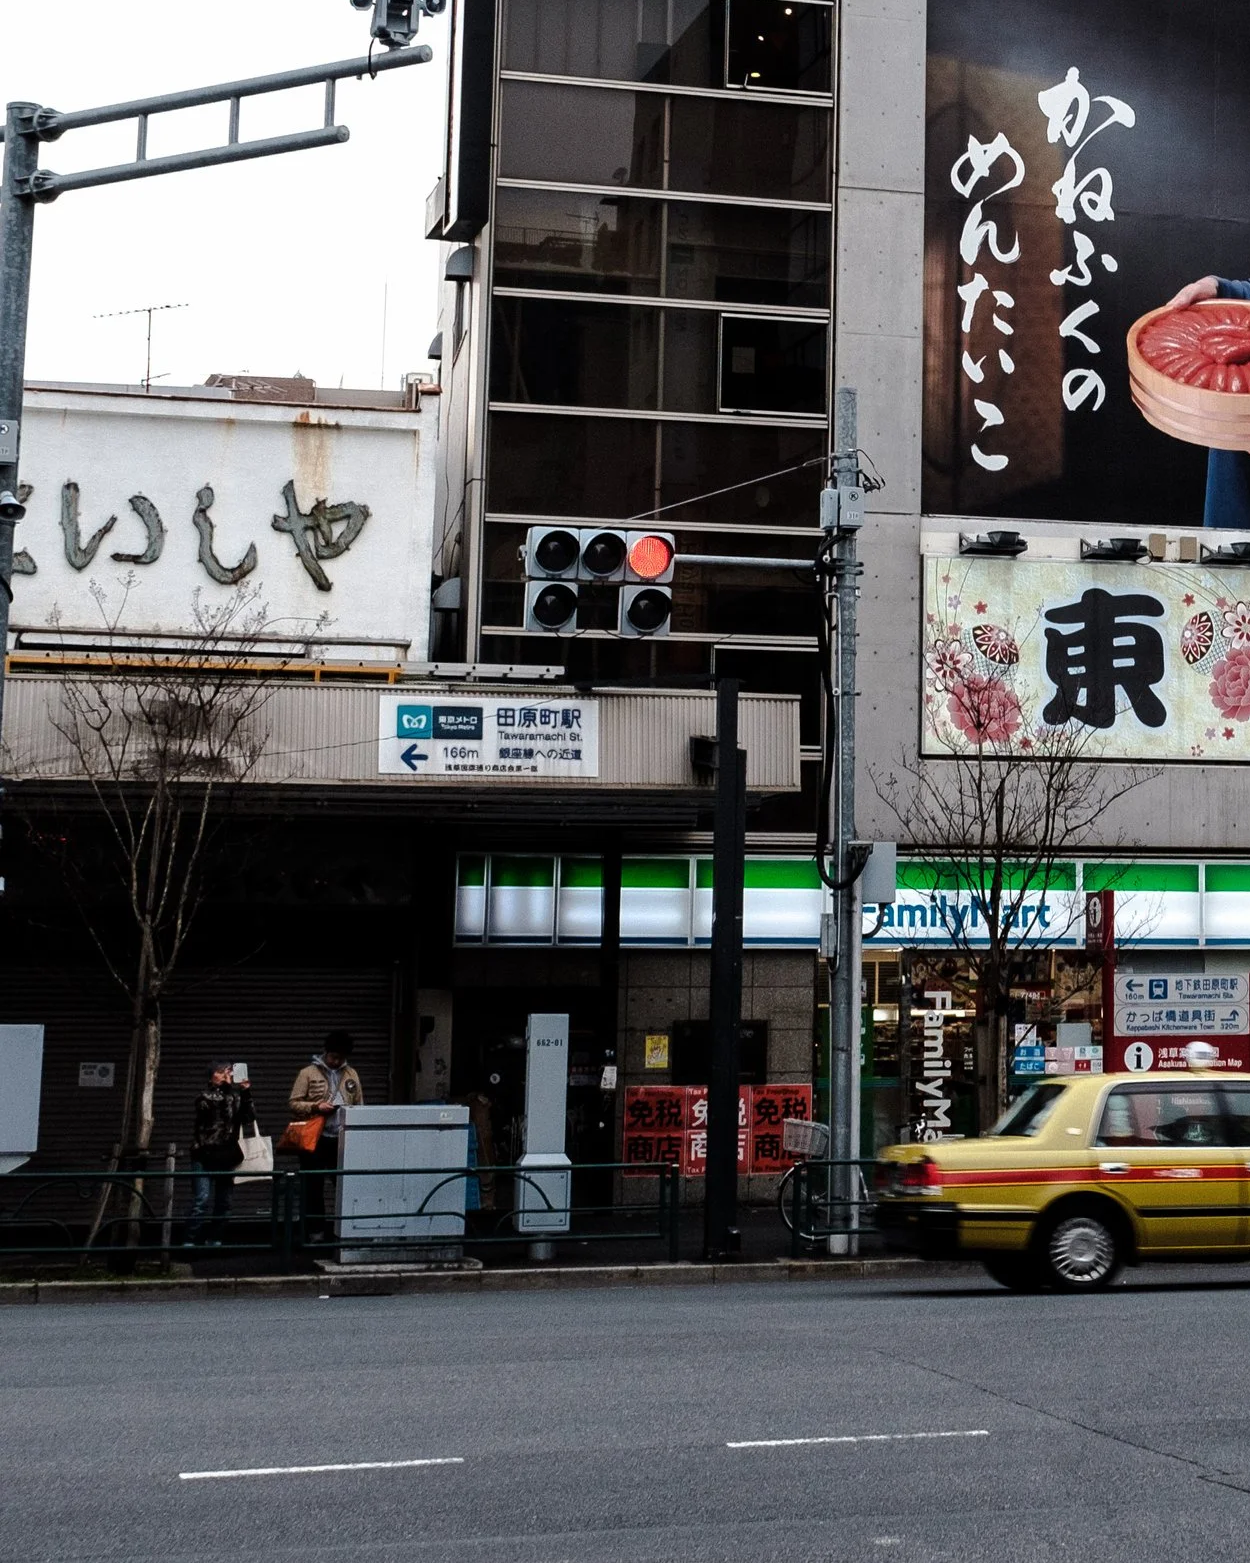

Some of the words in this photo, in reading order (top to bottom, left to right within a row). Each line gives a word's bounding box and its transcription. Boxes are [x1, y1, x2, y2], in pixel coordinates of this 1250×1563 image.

[1037, 65, 1137, 412] かねふくの
[950, 131, 1026, 472] めんたいこ
[497, 707, 582, 729] 田原町駅
[498, 731, 567, 741] Tawaramachi
[569, 732, 583, 741] St.
[443, 747, 479, 759] 166m
[499, 747, 583, 761] 銀座線への近道
[1175, 978, 1239, 991] 地下鉄田原町駅
[1179, 992, 1221, 1000] Tawaramachi
[1126, 1009, 1216, 1023] かっぱ橋道具街
[1020, 1062, 1040, 1070] たばこ
[1158, 1059, 1187, 1068] Asakusa
[1228, 1058, 1243, 1069] Map
[628, 1098, 683, 1127] 免税
[755, 1097, 808, 1126] 免税
[628, 1134, 680, 1164] 商店
